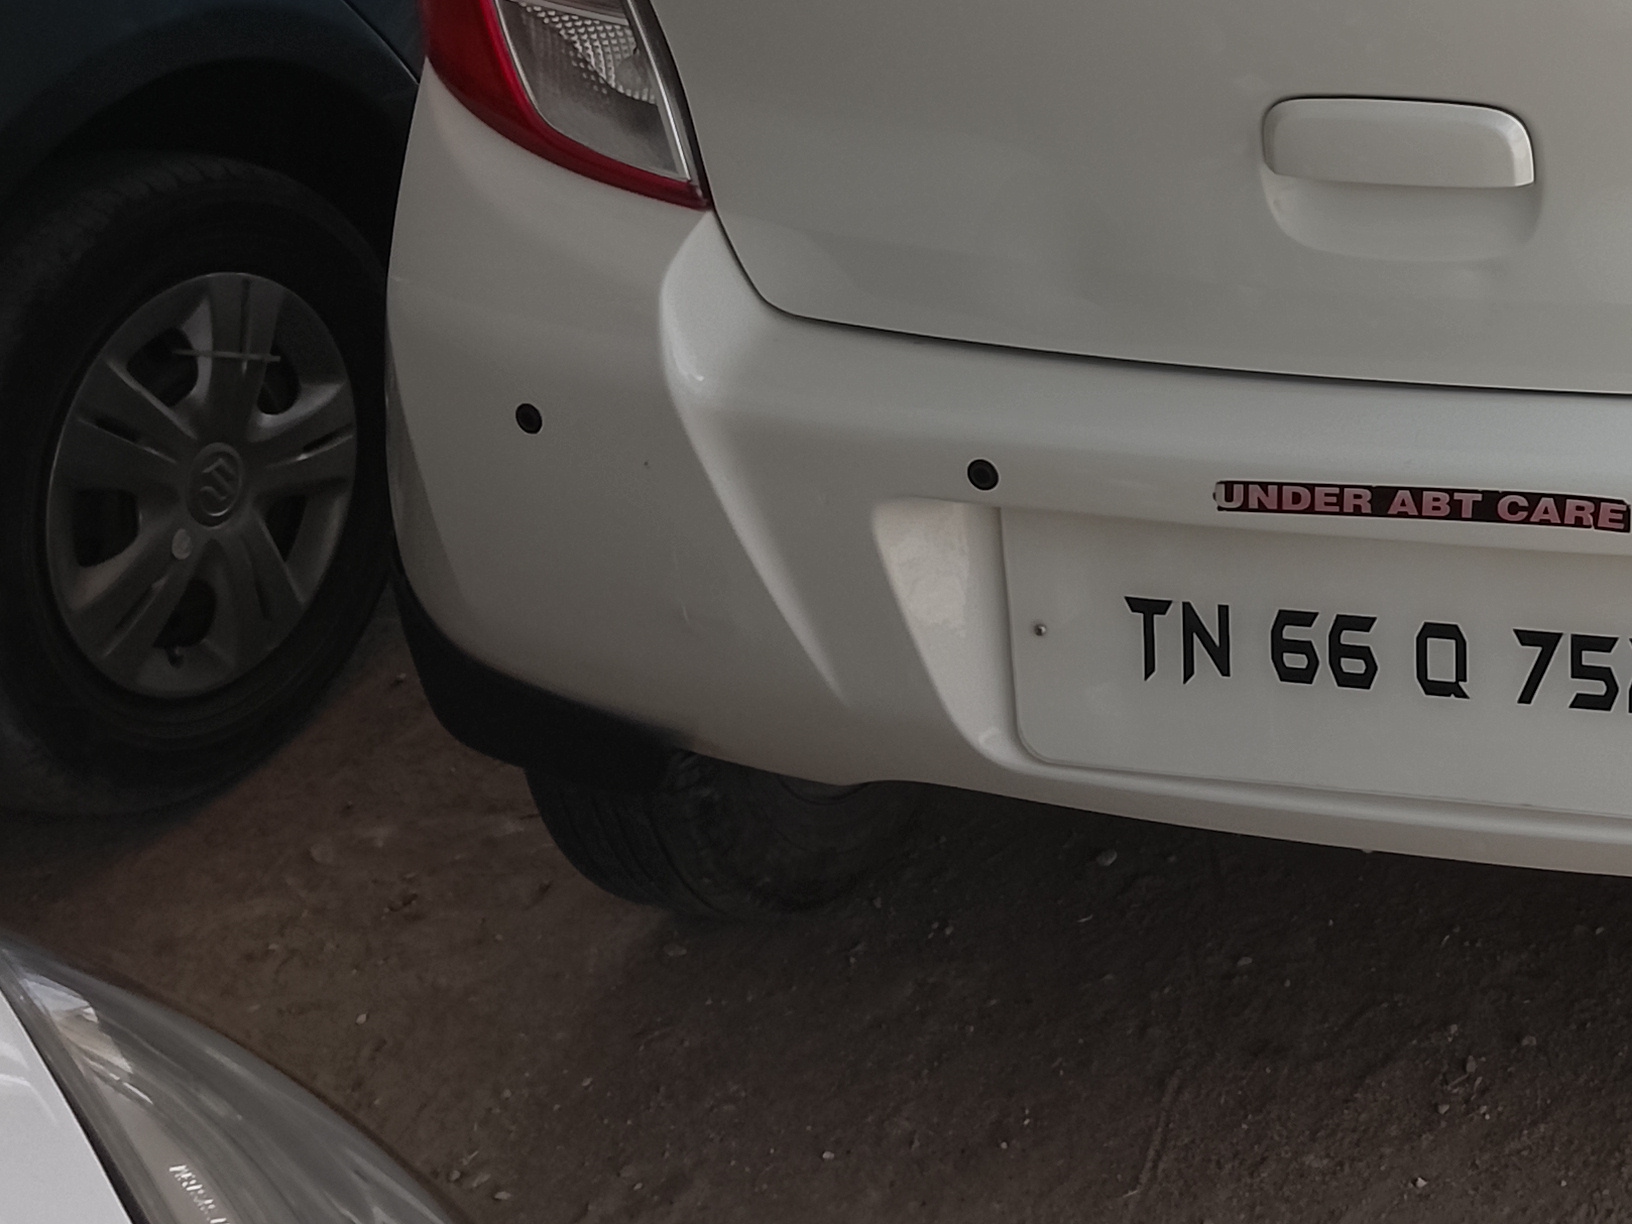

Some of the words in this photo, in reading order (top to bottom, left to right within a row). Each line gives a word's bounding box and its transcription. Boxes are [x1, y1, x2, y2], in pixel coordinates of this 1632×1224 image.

[1214, 482, 1373, 514] UNDER
[1387, 489, 1483, 519] ABT
[1496, 494, 1628, 530] CARE
[1123, 595, 1231, 685] TN
[1270, 608, 1379, 691] 66
[1415, 621, 1471, 700] Q
